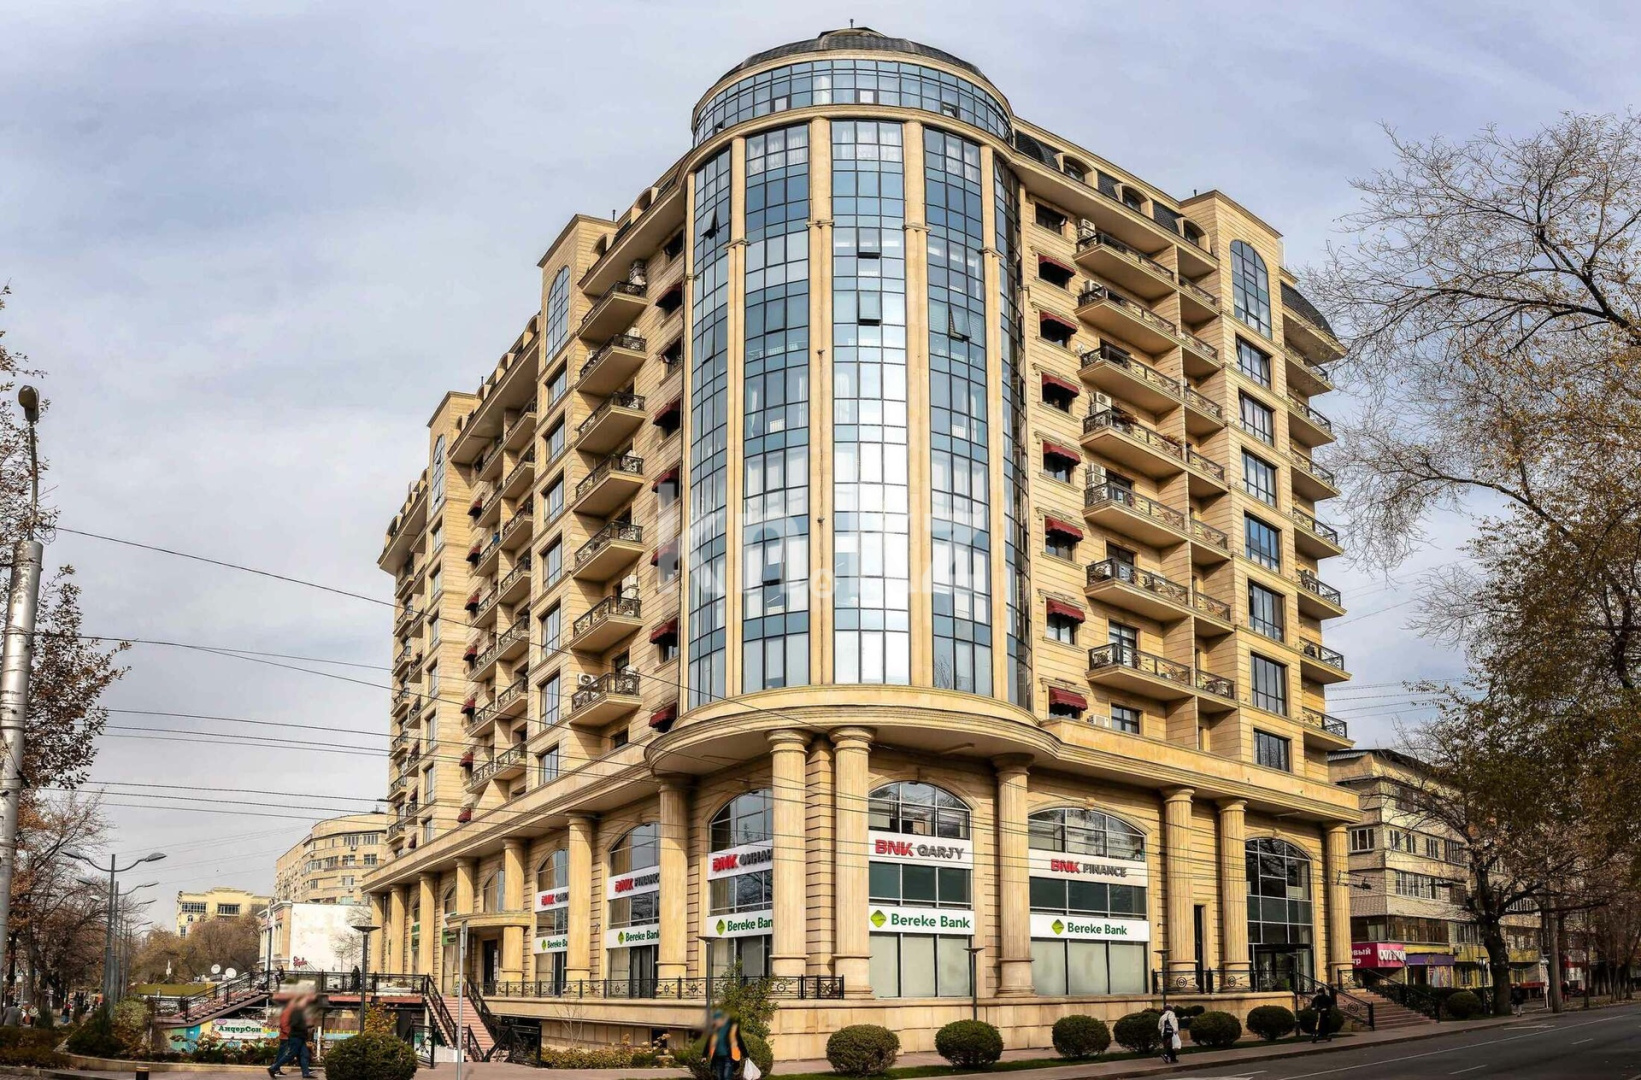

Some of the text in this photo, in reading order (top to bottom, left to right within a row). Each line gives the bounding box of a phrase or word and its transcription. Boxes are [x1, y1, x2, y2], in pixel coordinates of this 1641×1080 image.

[874, 839, 965, 860] BNK QARJY
[712, 853, 739, 873] BNK
[1050, 858, 1128, 878] BNK FINANCE
[634, 872, 660, 887] FINANC
[727, 917, 773, 932] Bereke Ban
[891, 913, 970, 929] Bereke Bank
[625, 931, 646, 942] Bereke
[1067, 922, 1128, 936] Bereke Bank
